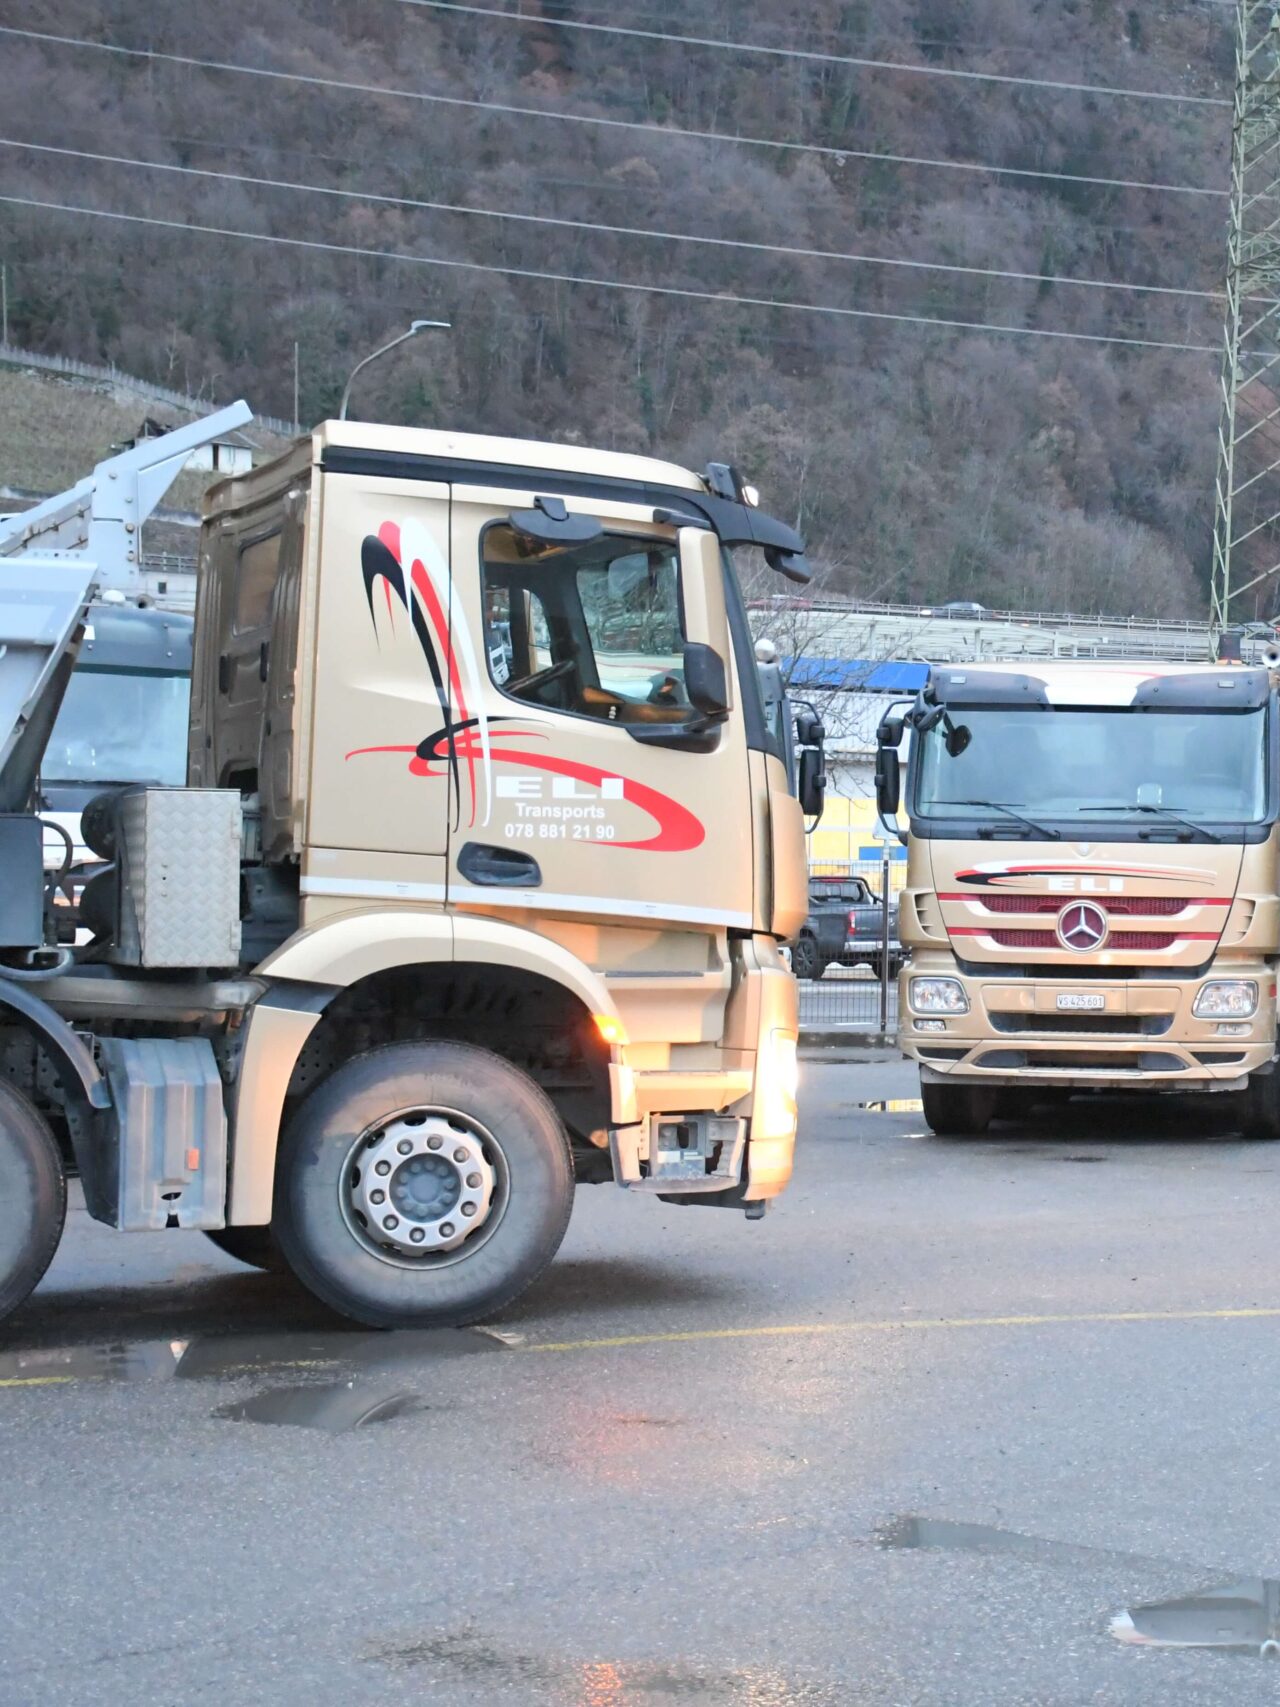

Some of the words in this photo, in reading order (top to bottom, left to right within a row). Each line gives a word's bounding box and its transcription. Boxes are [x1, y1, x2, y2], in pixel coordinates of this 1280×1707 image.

[496, 775, 624, 800] ELI
[515, 802, 605, 821] Transports
[505, 823, 534, 838] 078
[539, 823, 566, 838] 881
[572, 825, 590, 839] 21
[596, 825, 615, 839] 90
[1048, 878, 1123, 892] ELI
